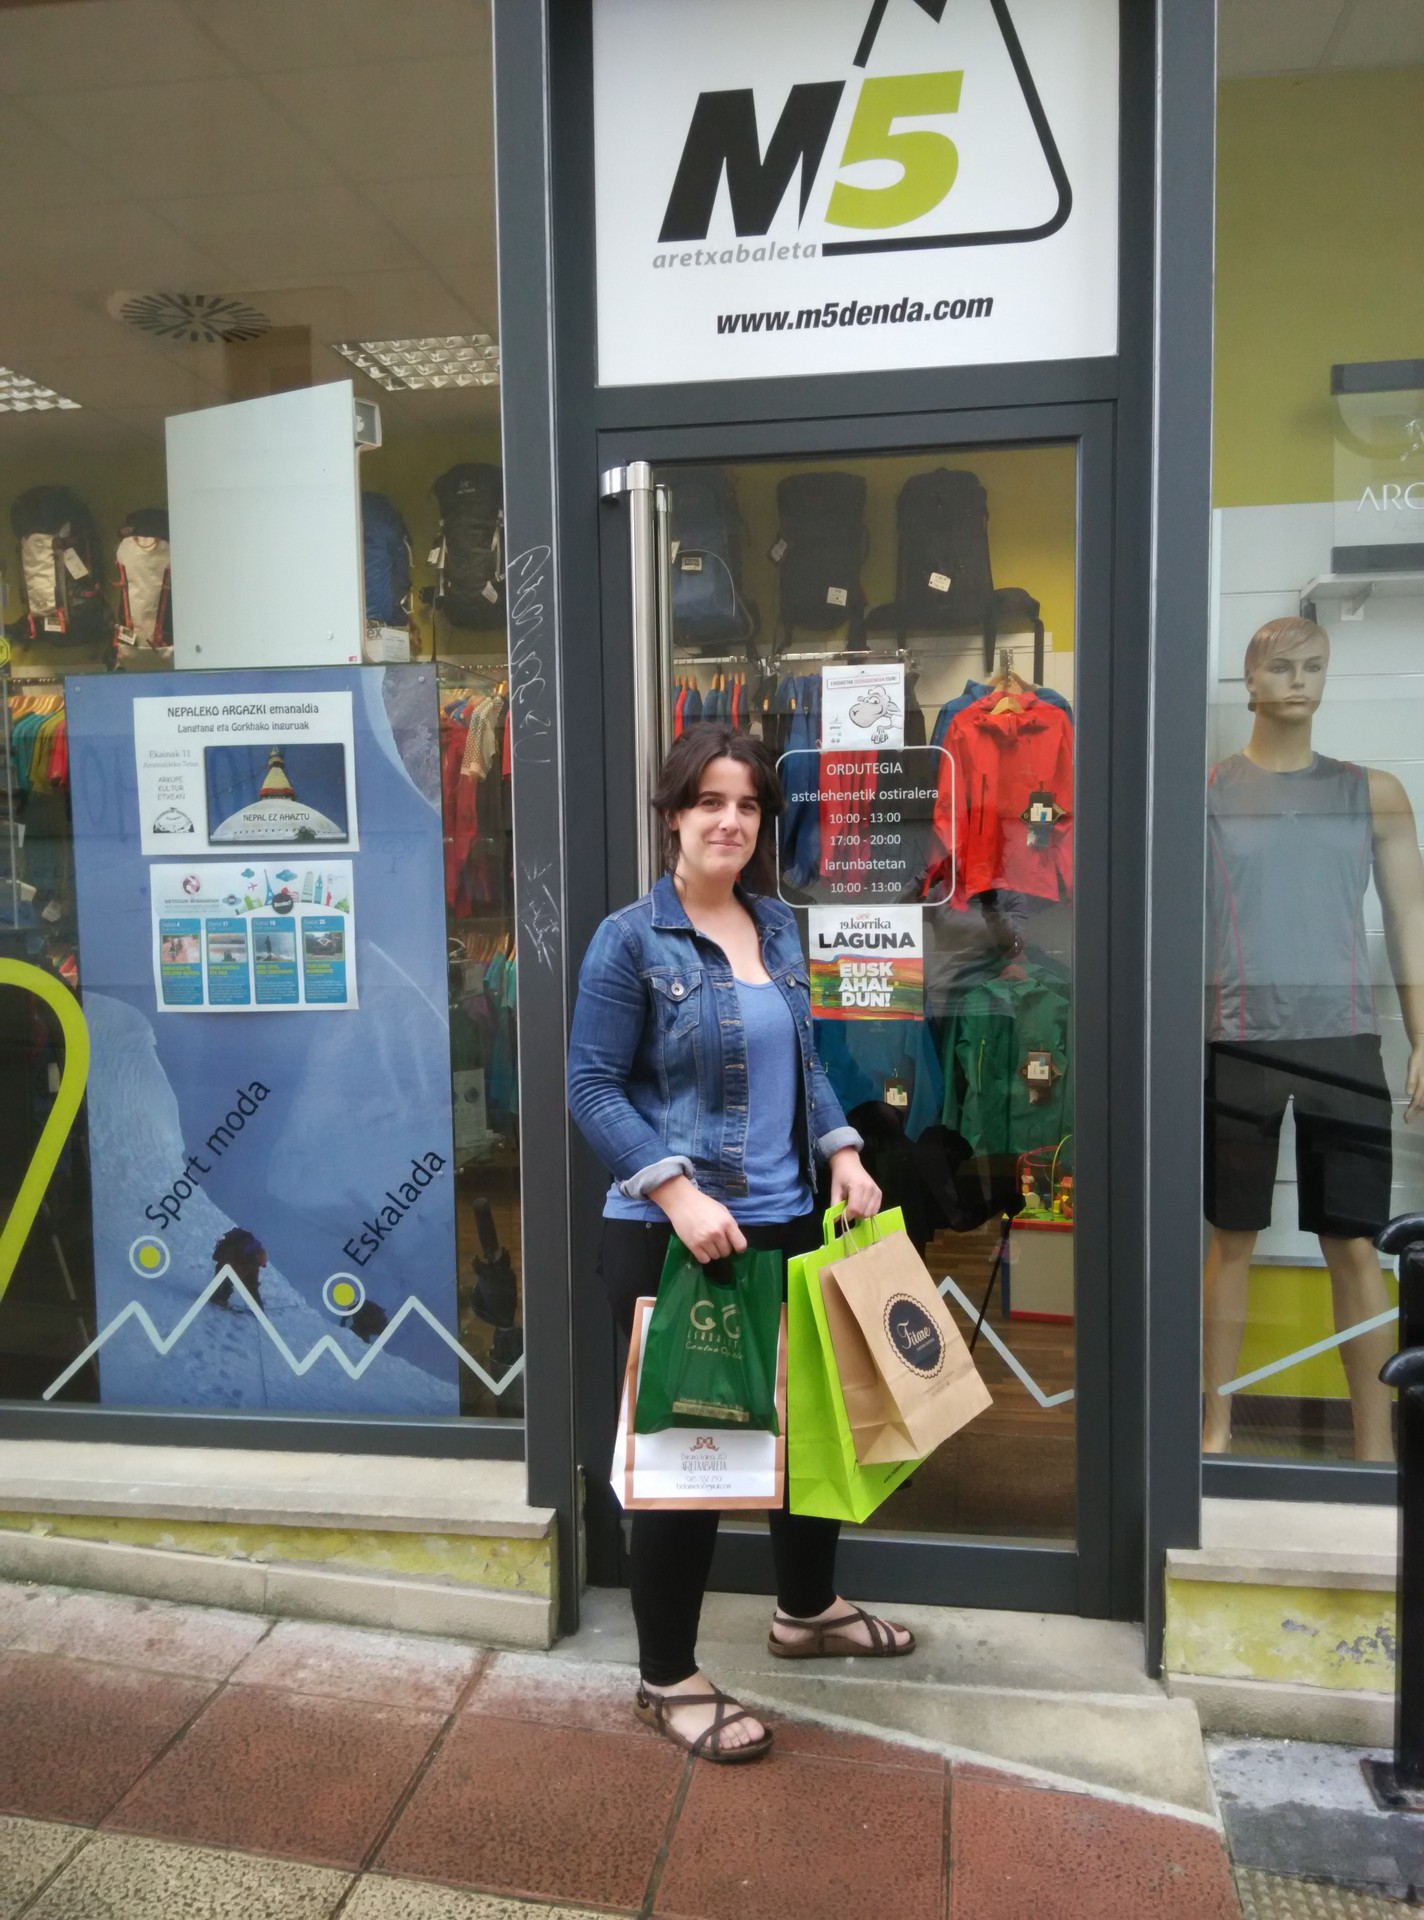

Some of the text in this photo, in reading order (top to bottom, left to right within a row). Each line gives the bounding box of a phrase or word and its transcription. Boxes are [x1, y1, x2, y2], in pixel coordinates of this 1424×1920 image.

[657, 70, 964, 243] M5
[652, 242, 817, 269] aretxabaleta
[716, 296, 993, 334] www.m5denda.com
[168, 703, 319, 717] NEPALEKO ARGAZKI emanaldia
[178, 721, 309, 733] Langtang eta Gorkhako inguruak
[149, 750, 180, 758] Ekainak
[826, 762, 903, 775] ORDUTEGIA
[791, 787, 939, 802] astelehenetik ostiralera
[830, 813, 860, 824] 10:00
[870, 812, 901, 823] 13:00
[830, 835, 860, 846] 17:00
[870, 834, 901, 845] 20:00
[825, 858, 906, 871] larunbatetan
[831, 882, 861, 893] 10:00
[871, 882, 902, 892] 13:00
[818, 932, 916, 949] LAGUNA
[839, 961, 894, 977] EUSK
[838, 977, 894, 992] AHAL
[841, 991, 891, 1007] DUN!
[144, 1154, 212, 1230] Sport
[205, 1080, 271, 1156] moda
[342, 1151, 447, 1267] Eskalada
